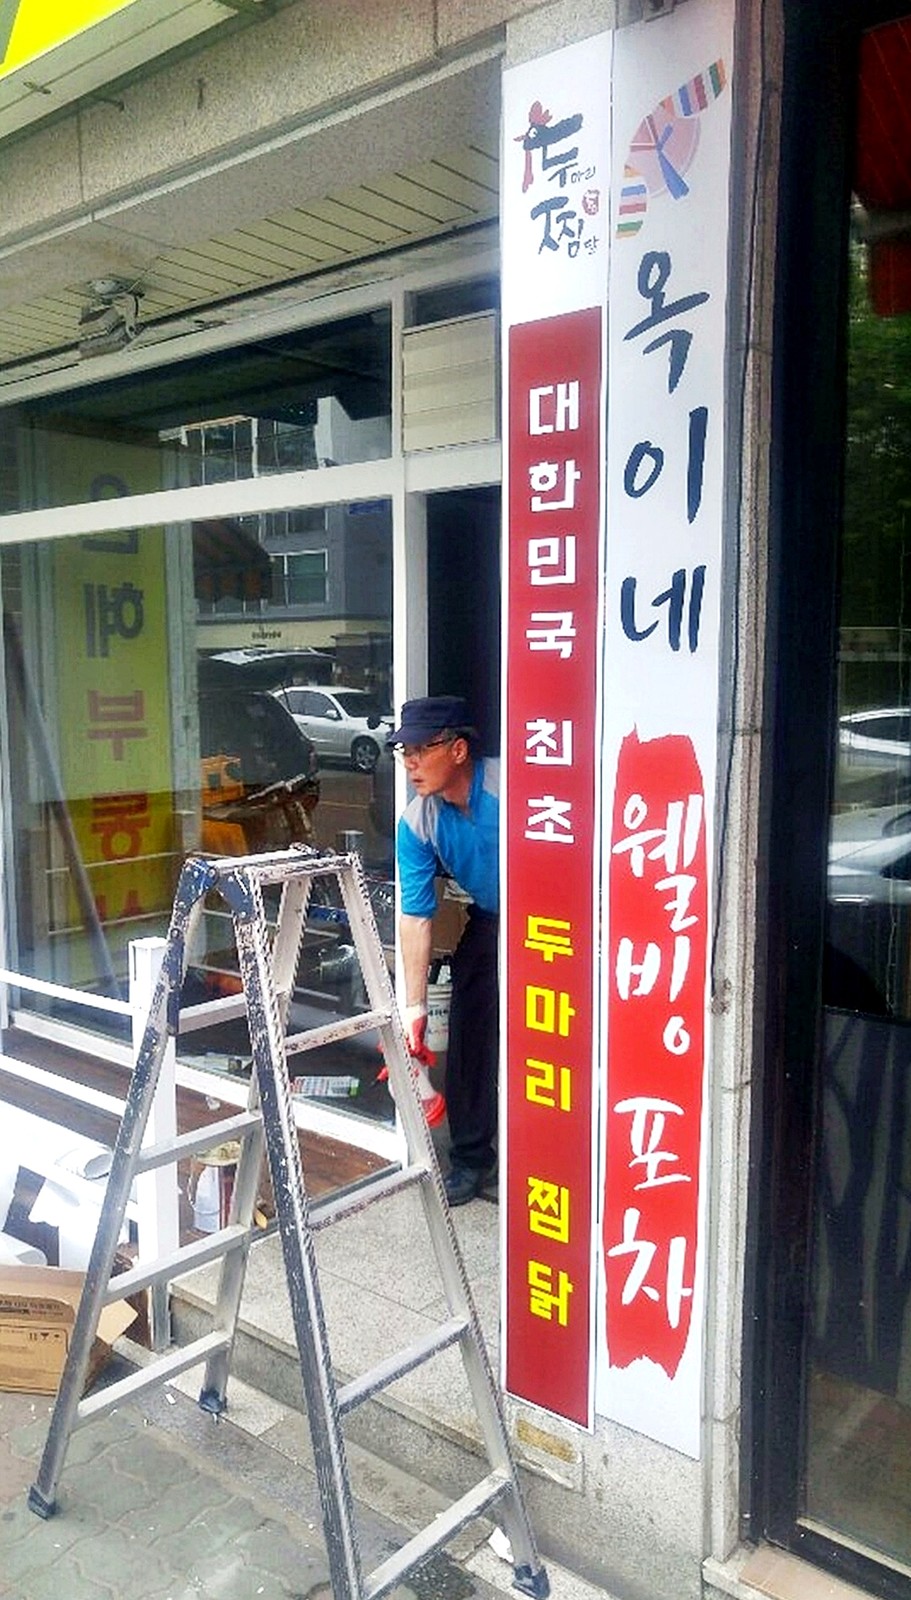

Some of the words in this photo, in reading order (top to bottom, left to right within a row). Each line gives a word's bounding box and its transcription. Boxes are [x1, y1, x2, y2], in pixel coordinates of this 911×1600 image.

[526, 380, 581, 659] 대한민국
[621, 250, 709, 653] 옥이네
[525, 719, 574, 843] 최초
[525, 915, 576, 1112] 두마리
[612, 794, 704, 1055] 웰빙
[528, 1177, 573, 1326] 찜닭
[608, 1097, 693, 1328] 포차
